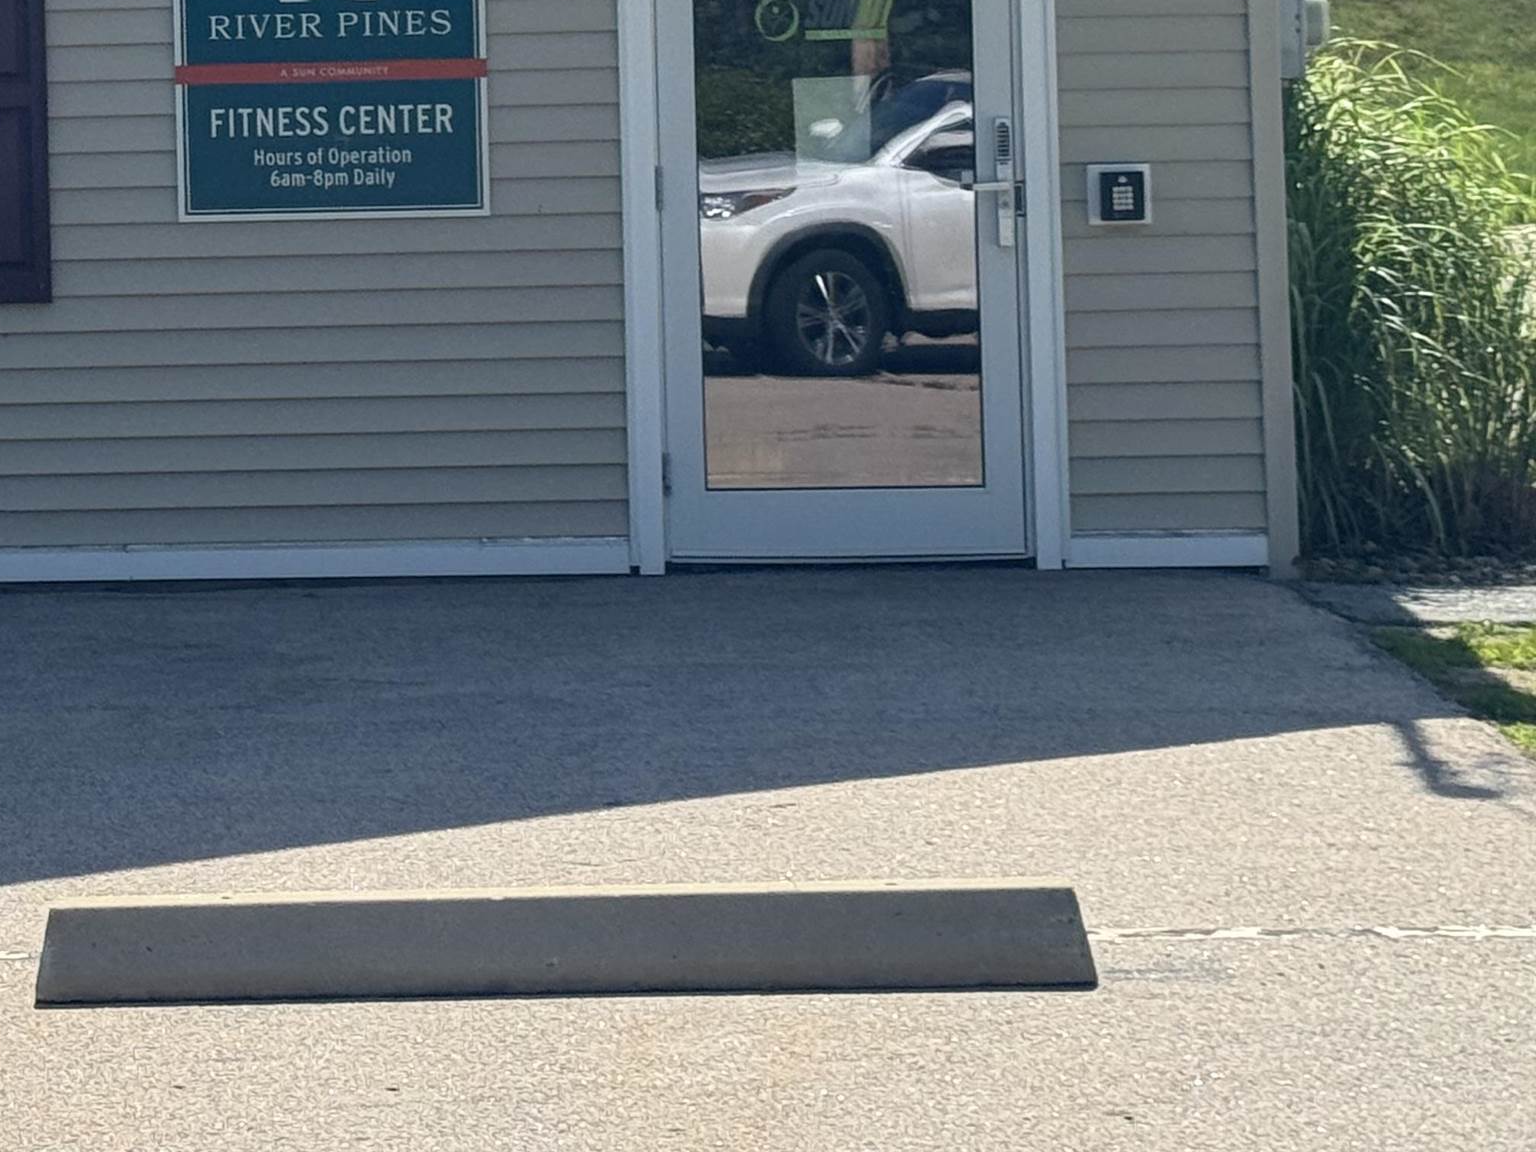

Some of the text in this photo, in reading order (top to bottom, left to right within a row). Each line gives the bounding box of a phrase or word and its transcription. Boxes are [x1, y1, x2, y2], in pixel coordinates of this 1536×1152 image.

[208, 9, 452, 40] RIVER PINES
[280, 65, 389, 78] A SUN COMMUNITY
[210, 103, 453, 138] FITNESS CENTER
[253, 146, 412, 168] Hours of Operation
[270, 167, 396, 189] 6am-8pm Daily
